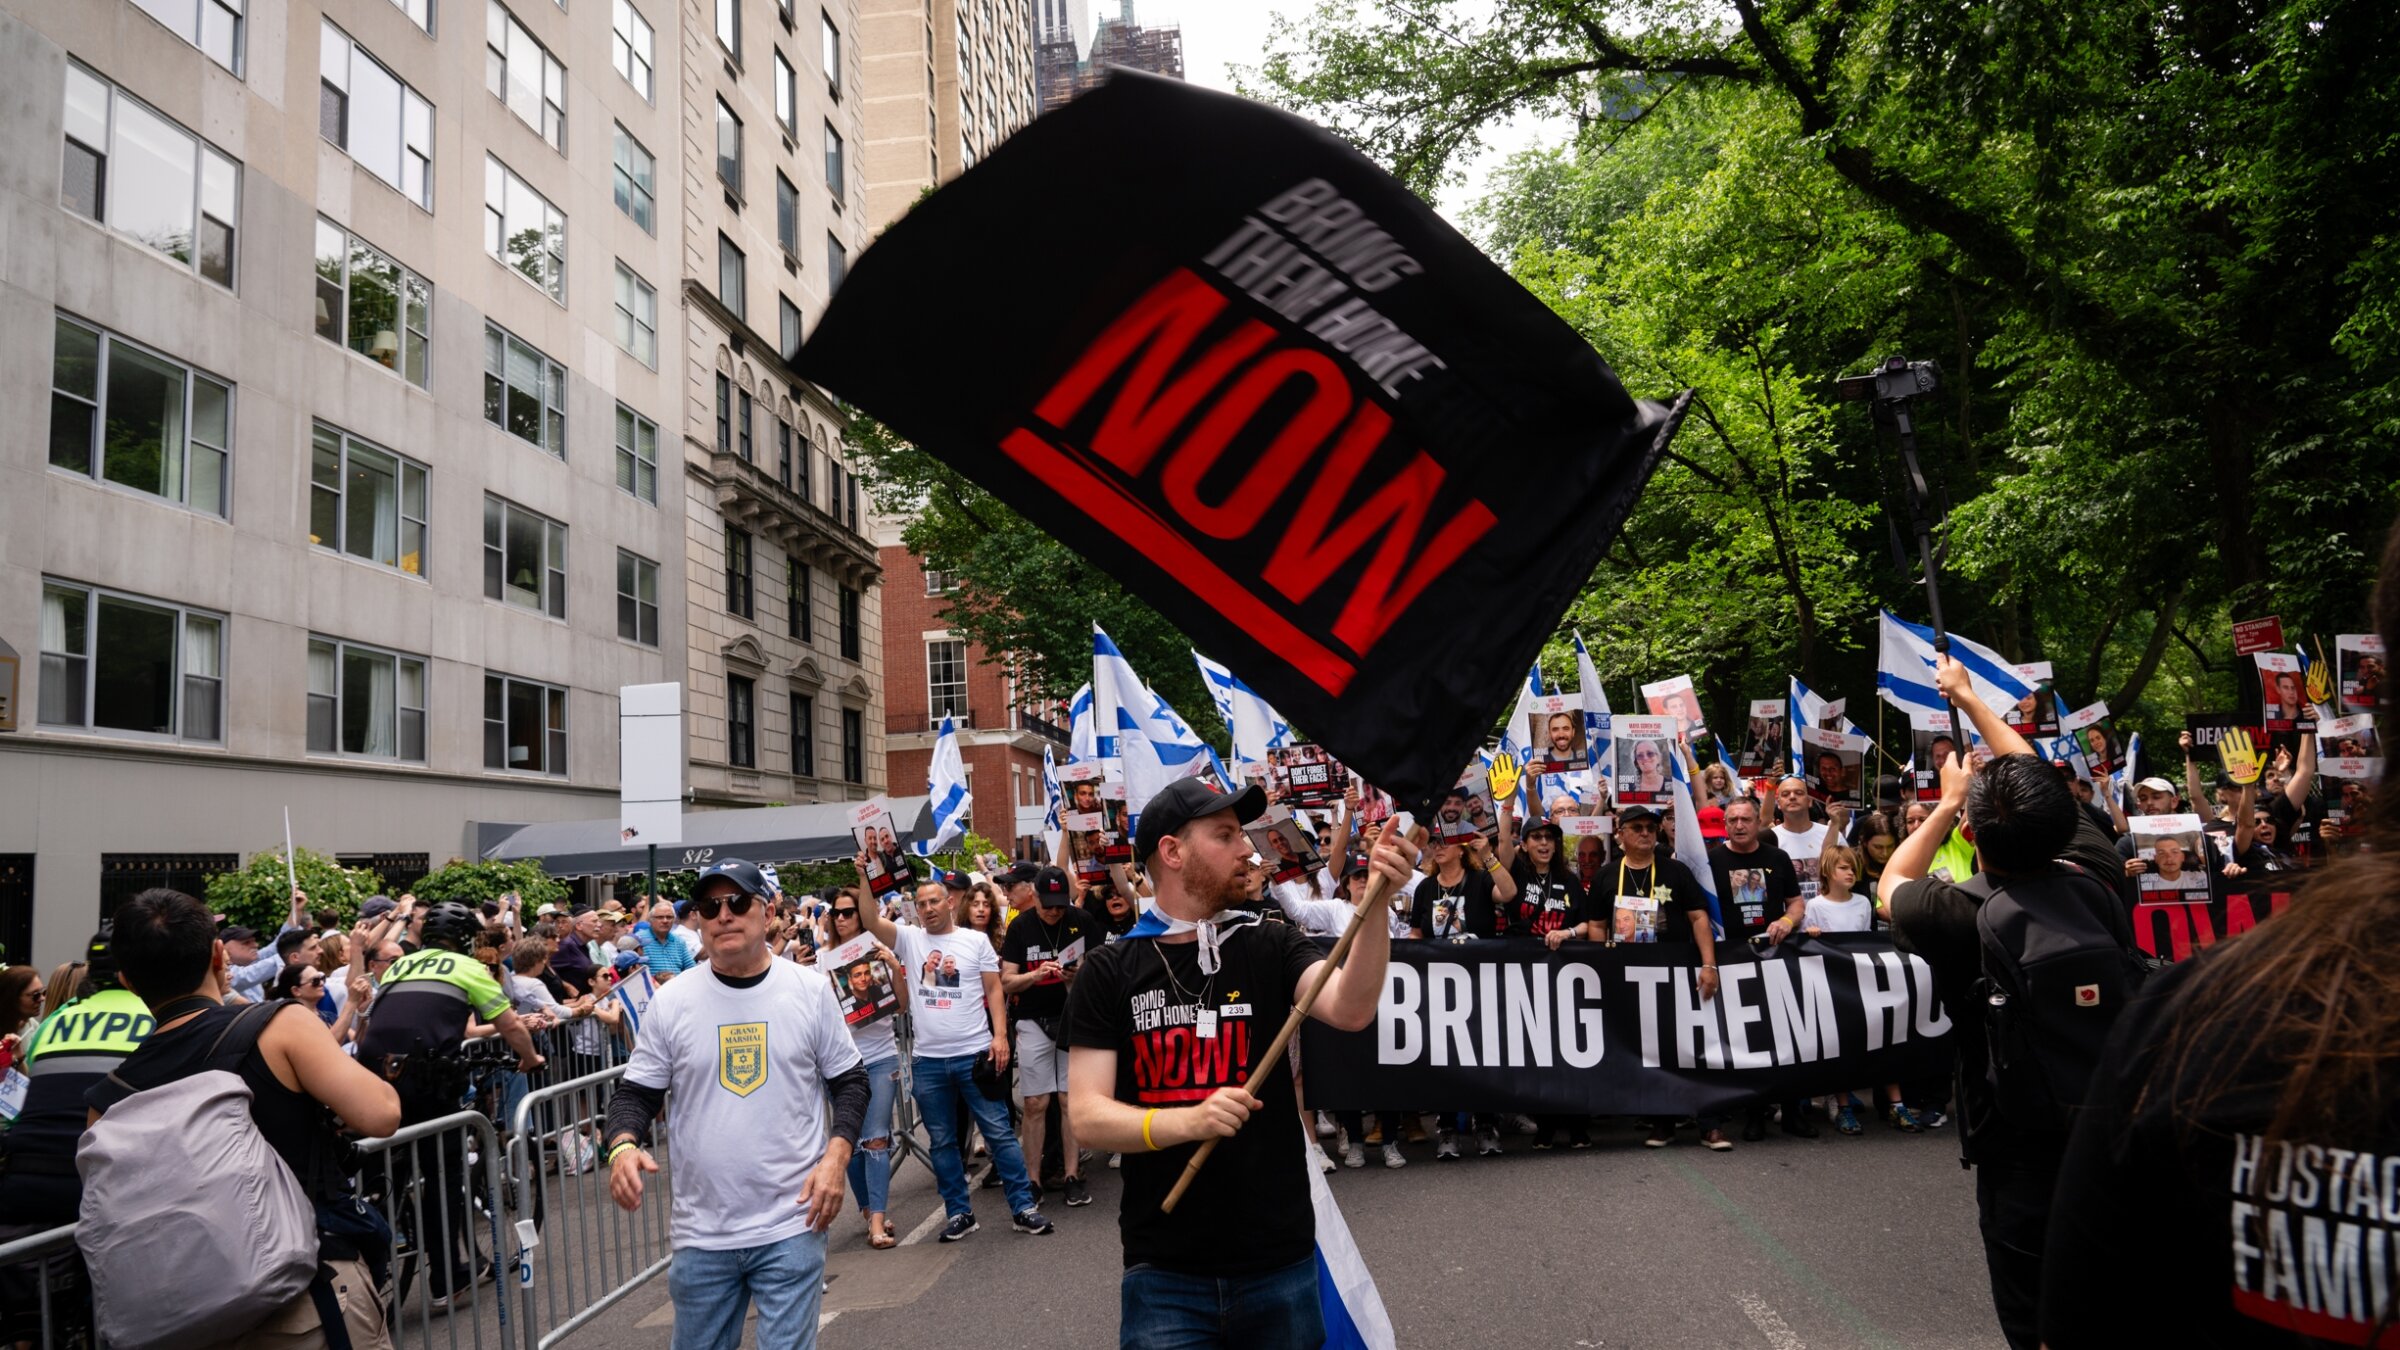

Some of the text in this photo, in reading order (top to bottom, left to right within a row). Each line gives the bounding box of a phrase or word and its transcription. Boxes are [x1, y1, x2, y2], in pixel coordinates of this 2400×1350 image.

[1257, 177, 1425, 293] BRING
[1202, 215, 1448, 400] THEM HOME
[1032, 266, 1499, 659] NOW
[2244, 620, 2273, 632] STANDING
[2196, 727, 2227, 745] DEA
[1290, 764, 1327, 775] DON'T FORGET
[1916, 771, 1934, 780] BRING
[1292, 773, 1328, 785] THEIR FACES
[1618, 775, 1635, 783] BRING
[1618, 783, 1630, 791] HER
[682, 848, 714, 865] 812
[386, 958, 455, 977] NYPD
[1131, 989, 1165, 1015] BRING
[1228, 1006, 1244, 1014] 239
[1133, 1004, 1197, 1031] THEM HOME
[1378, 961, 1604, 1068] BRING
[1625, 954, 1840, 1070] THEM
[47, 1012, 157, 1044] NYPD
[730, 1027, 758, 1035] GRAND
[725, 1034, 763, 1044] MARSHAL
[1131, 1020, 1248, 1089] NOW!
